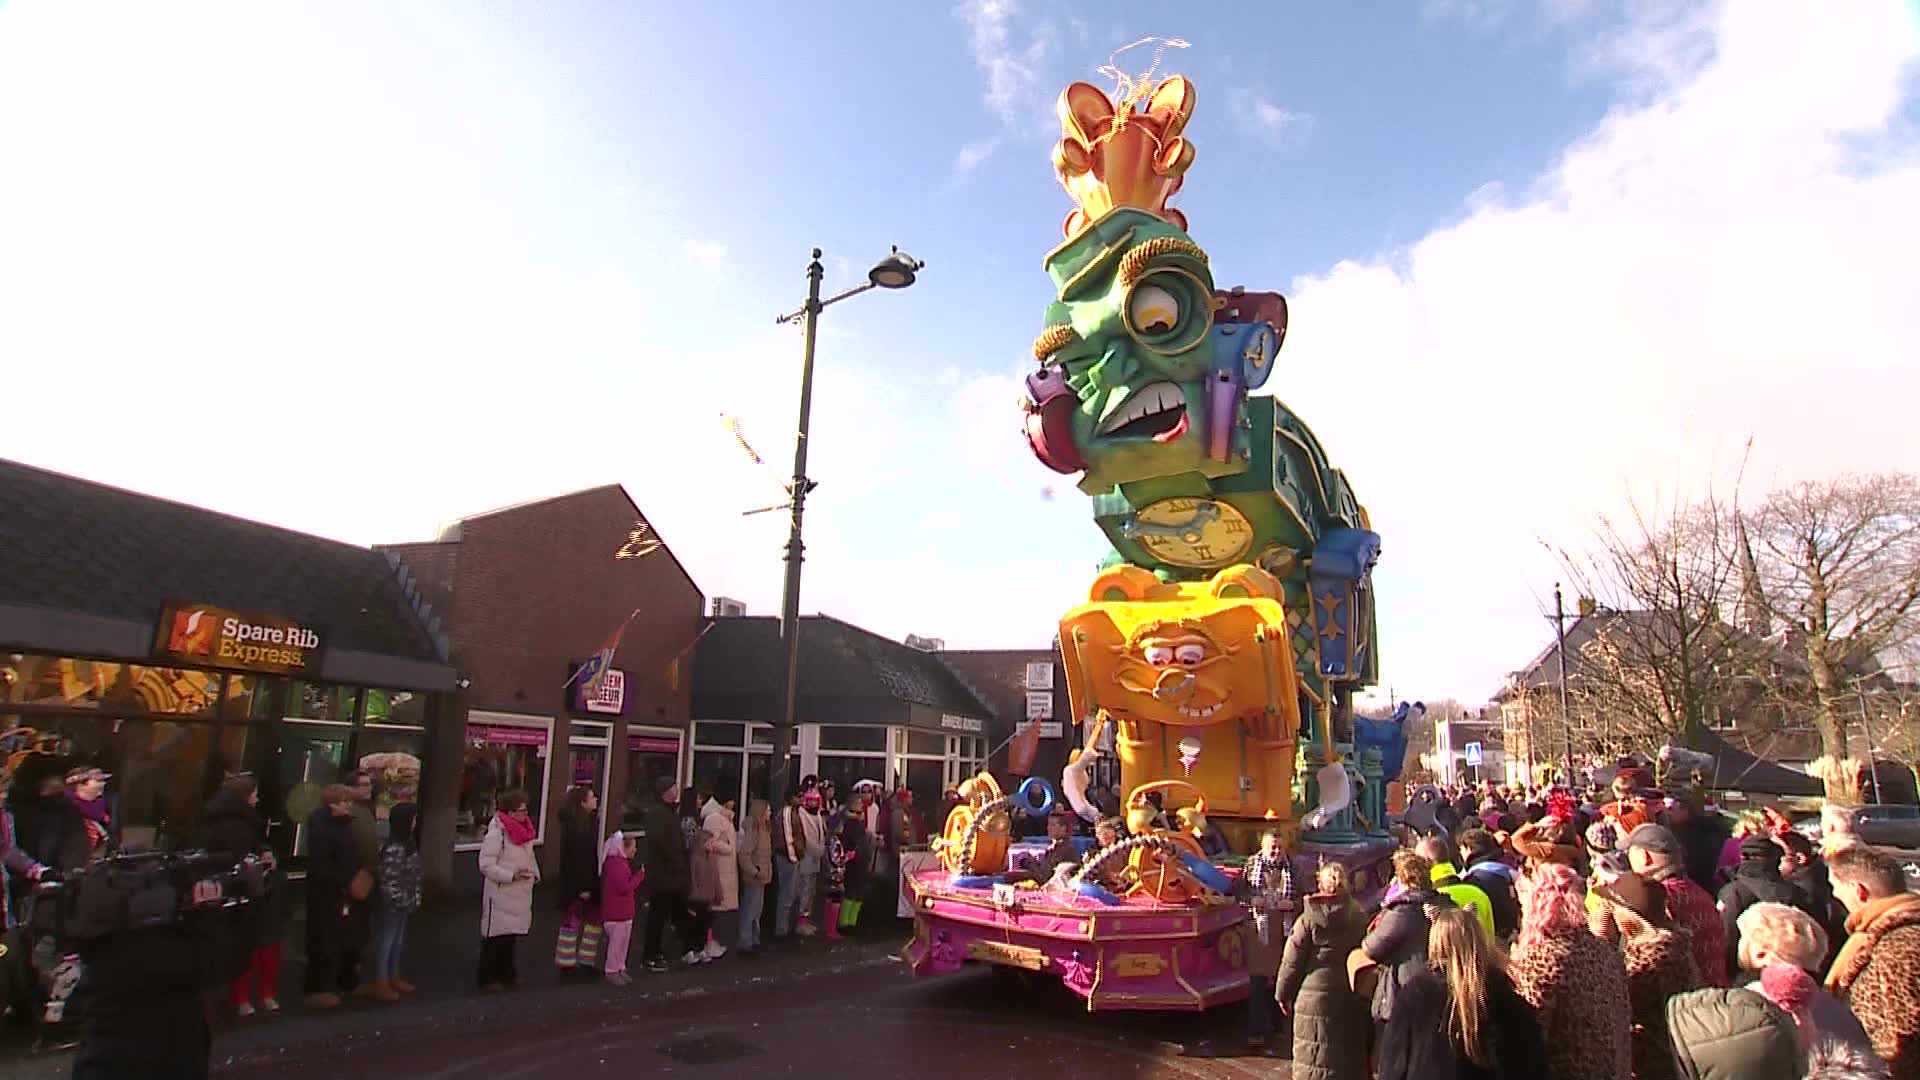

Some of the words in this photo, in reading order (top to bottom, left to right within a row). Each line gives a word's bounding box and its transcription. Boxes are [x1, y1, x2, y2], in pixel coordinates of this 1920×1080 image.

[221, 617, 283, 643] Spare
[285, 627, 319, 649] Rib
[218, 638, 305, 666] Express.
